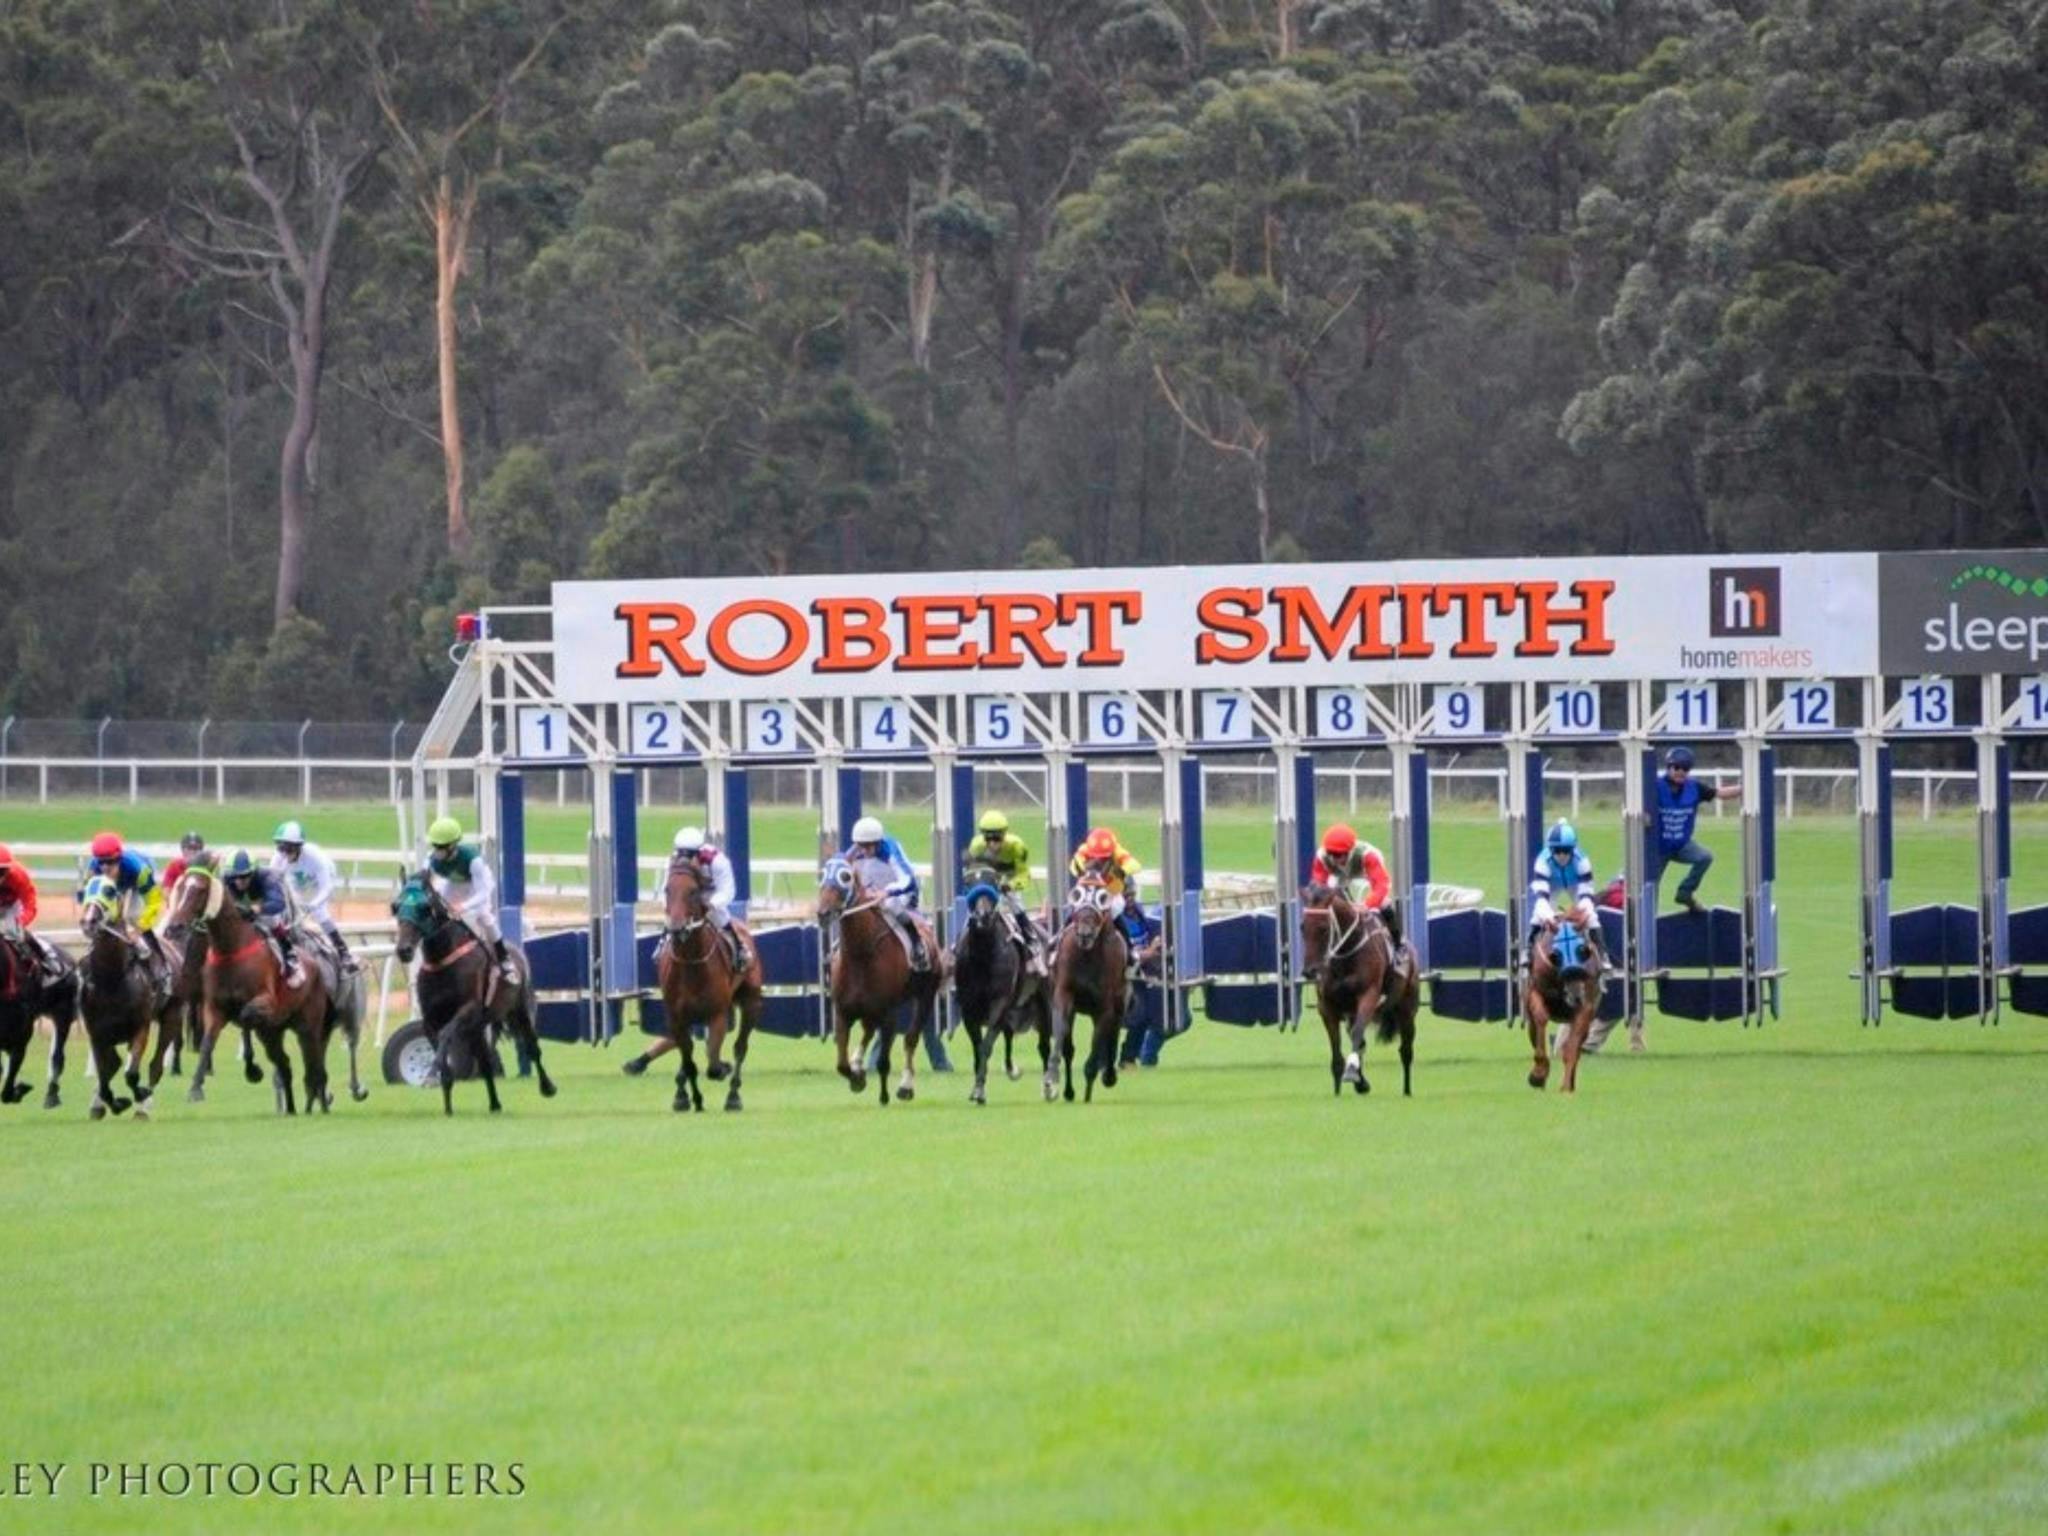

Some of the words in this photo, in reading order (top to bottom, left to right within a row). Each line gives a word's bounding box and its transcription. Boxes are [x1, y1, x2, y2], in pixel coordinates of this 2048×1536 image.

[615, 591, 1142, 677] ROBERT
[1195, 580, 1615, 665] SMITH
[1680, 644, 1813, 669] homemakers
[1101, 701, 1125, 737] 6
[1215, 697, 1239, 734] 7
[1330, 694, 1354, 732] 8
[1447, 692, 1471, 729] 9
[1554, 690, 1595, 727] 10
[1674, 688, 1709, 726] 11
[1789, 686, 1830, 725] 12
[1907, 685, 1949, 724] 13
[2026, 683, 2048, 721] 1
[536, 714, 551, 750] 1
[646, 711, 668, 748] 2
[761, 708, 783, 746] 3
[874, 706, 896, 742] 4
[988, 703, 1011, 740] 5
